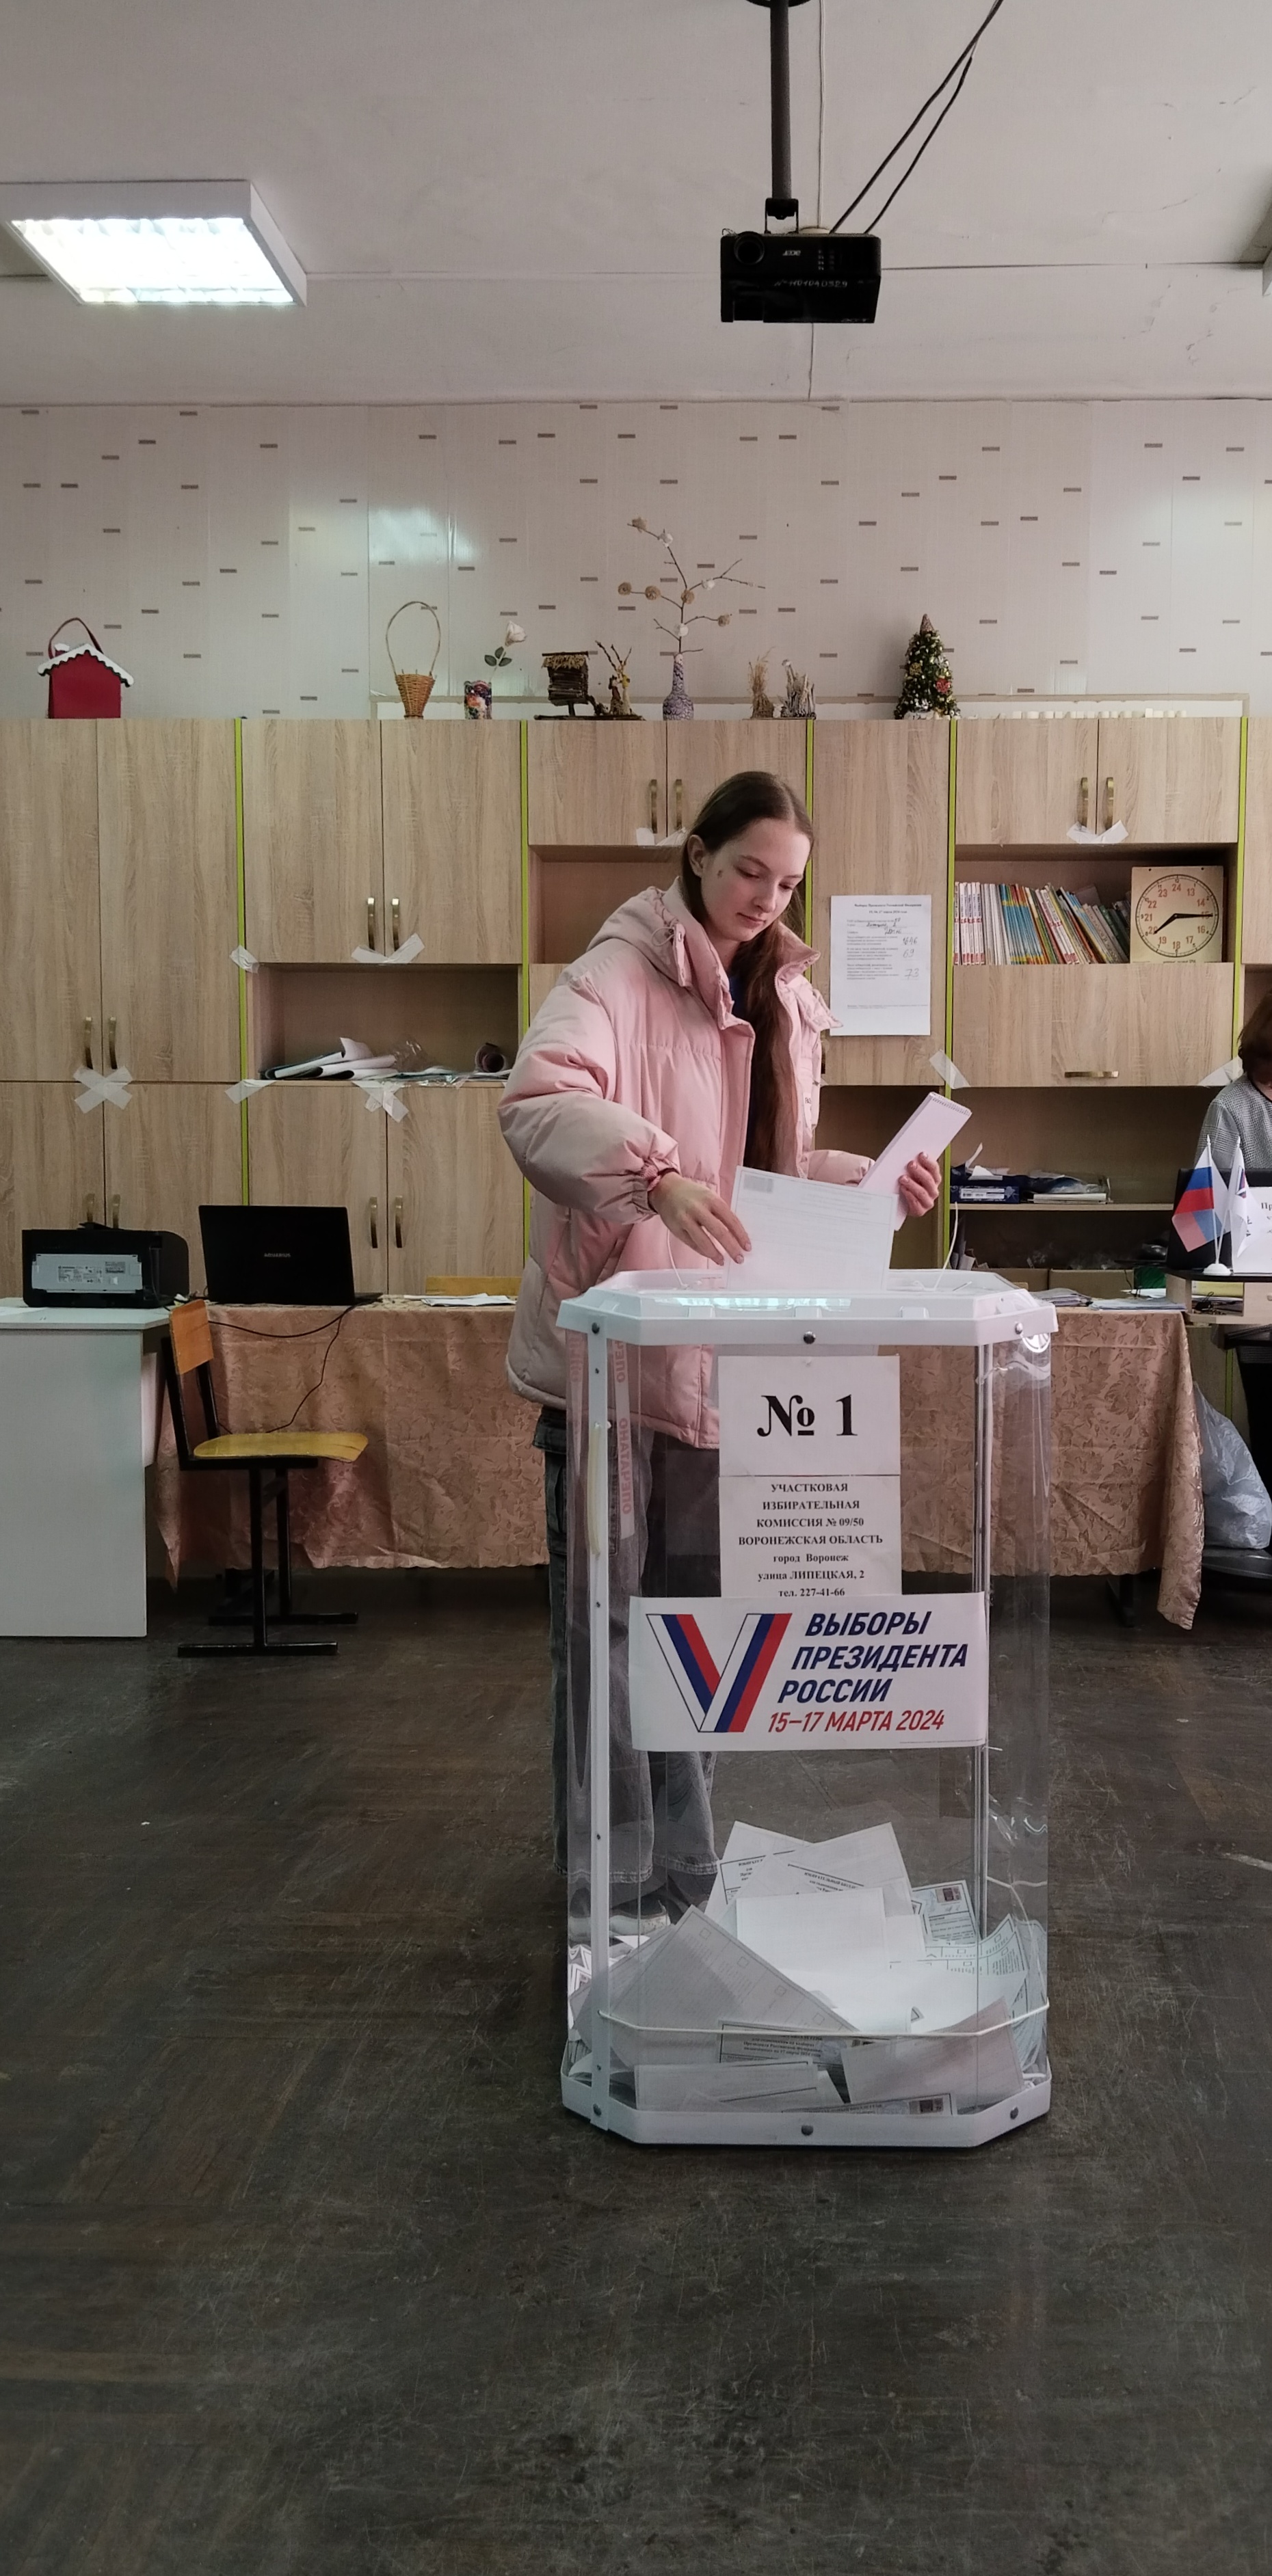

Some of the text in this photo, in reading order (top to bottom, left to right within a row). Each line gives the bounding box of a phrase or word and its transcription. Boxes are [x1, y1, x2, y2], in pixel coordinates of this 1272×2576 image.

[1171, 883, 1182, 891] 24
[1187, 888, 1195, 896] 13
[1158, 889, 1167, 898] 23
[1148, 900, 1156, 909] 22
[1197, 899, 1205, 907] 14
[1144, 913, 1152, 922] 21
[1197, 925, 1206, 933] 16
[1159, 936, 1167, 944] 19
[1186, 936, 1194, 944] 17
[1173, 941, 1180, 950] 18
[903, 949, 914, 958] 69
[905, 968, 919, 979] 73
[757, 1395, 858, 1437] № 1
[771, 1483, 848, 1493] УЧАСТКОВАЯ
[763, 1500, 860, 1511] ИЗБИРАТЕЛЬНАЯ
[756, 1517, 864, 1528] КОМИССИЯ № 09/50
[738, 1534, 884, 1546] ВОРОНЕЖСКАЯ ОБЛАСТЬ
[773, 1553, 849, 1564] город Воронеж
[757, 1570, 865, 1583] улица ЛИПЕЦКАЯ, 2
[799, 1587, 845, 1597] 227-41-66
[804, 1611, 932, 1637] ВЫБОРЫ
[791, 1643, 968, 1673] ПРЕЗИДЕНТА
[777, 1678, 893, 1704] РОССИИ
[824, 1710, 893, 1732] МАРТА
[895, 1709, 945, 1731] 2024
